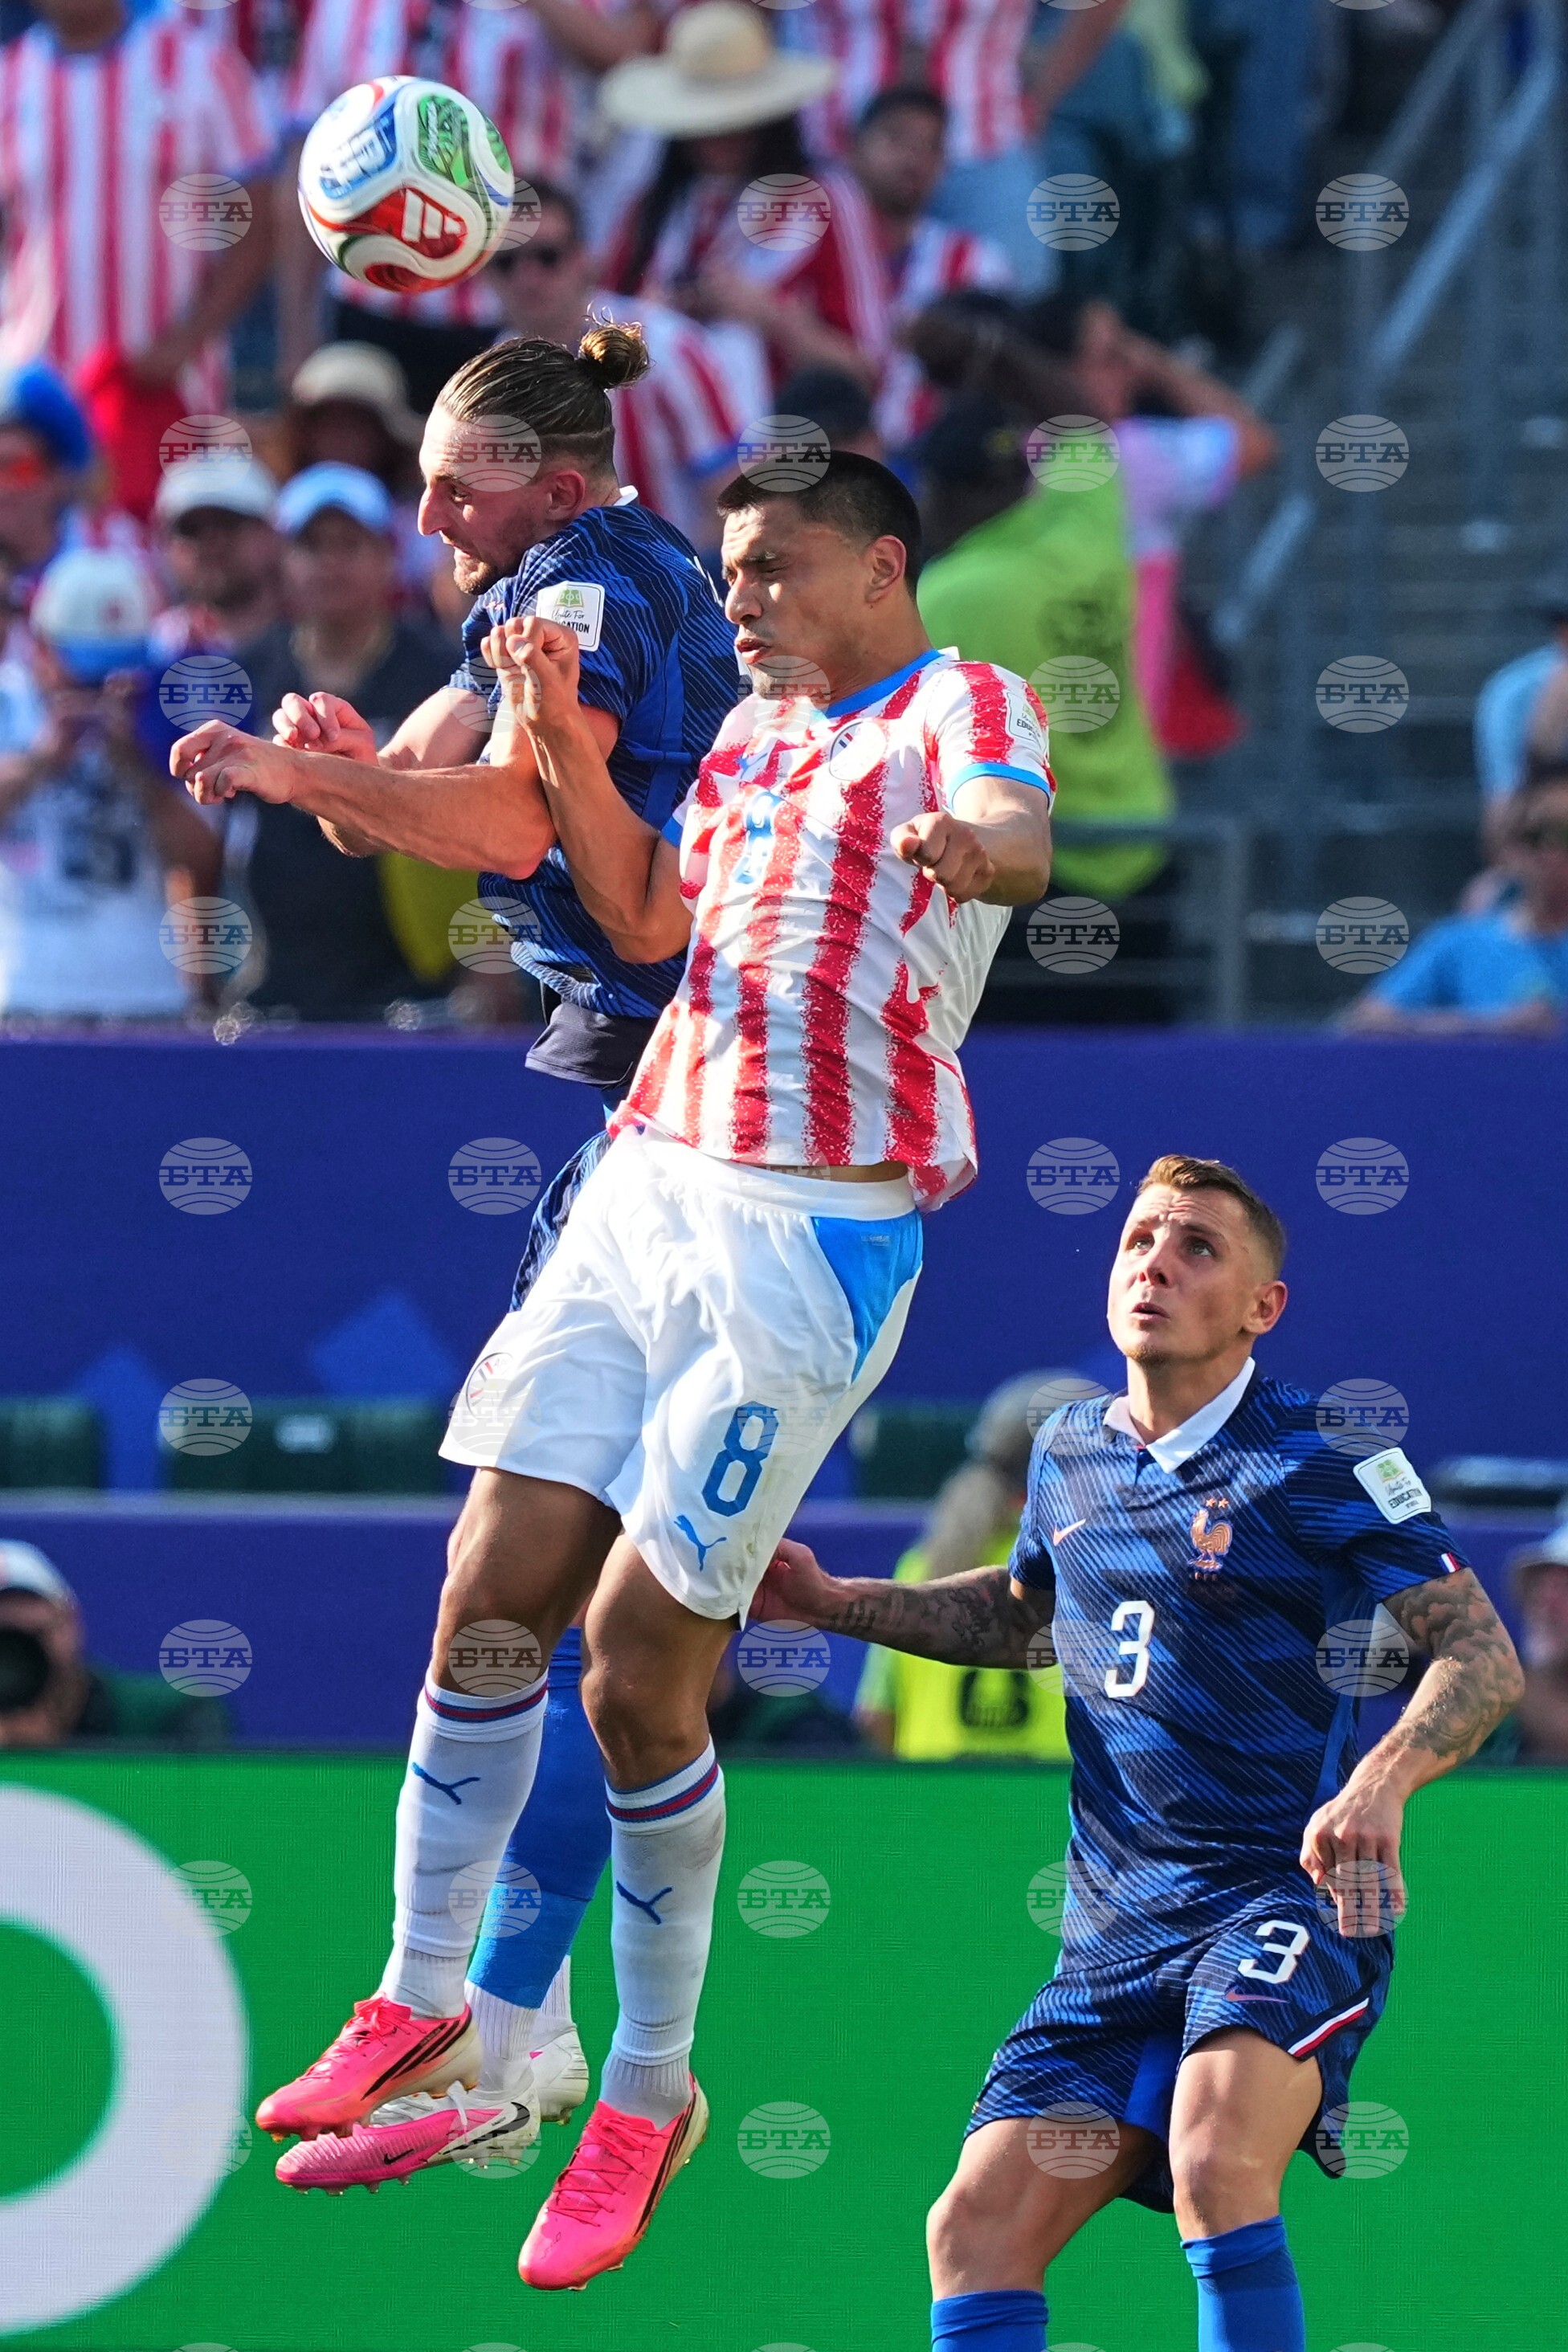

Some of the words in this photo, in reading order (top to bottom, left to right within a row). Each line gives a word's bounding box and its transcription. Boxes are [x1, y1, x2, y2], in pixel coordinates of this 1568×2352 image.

[701, 1400, 779, 1517] 8
[1104, 1600, 1155, 1698] 3
[1237, 1920, 1310, 1984] 3
